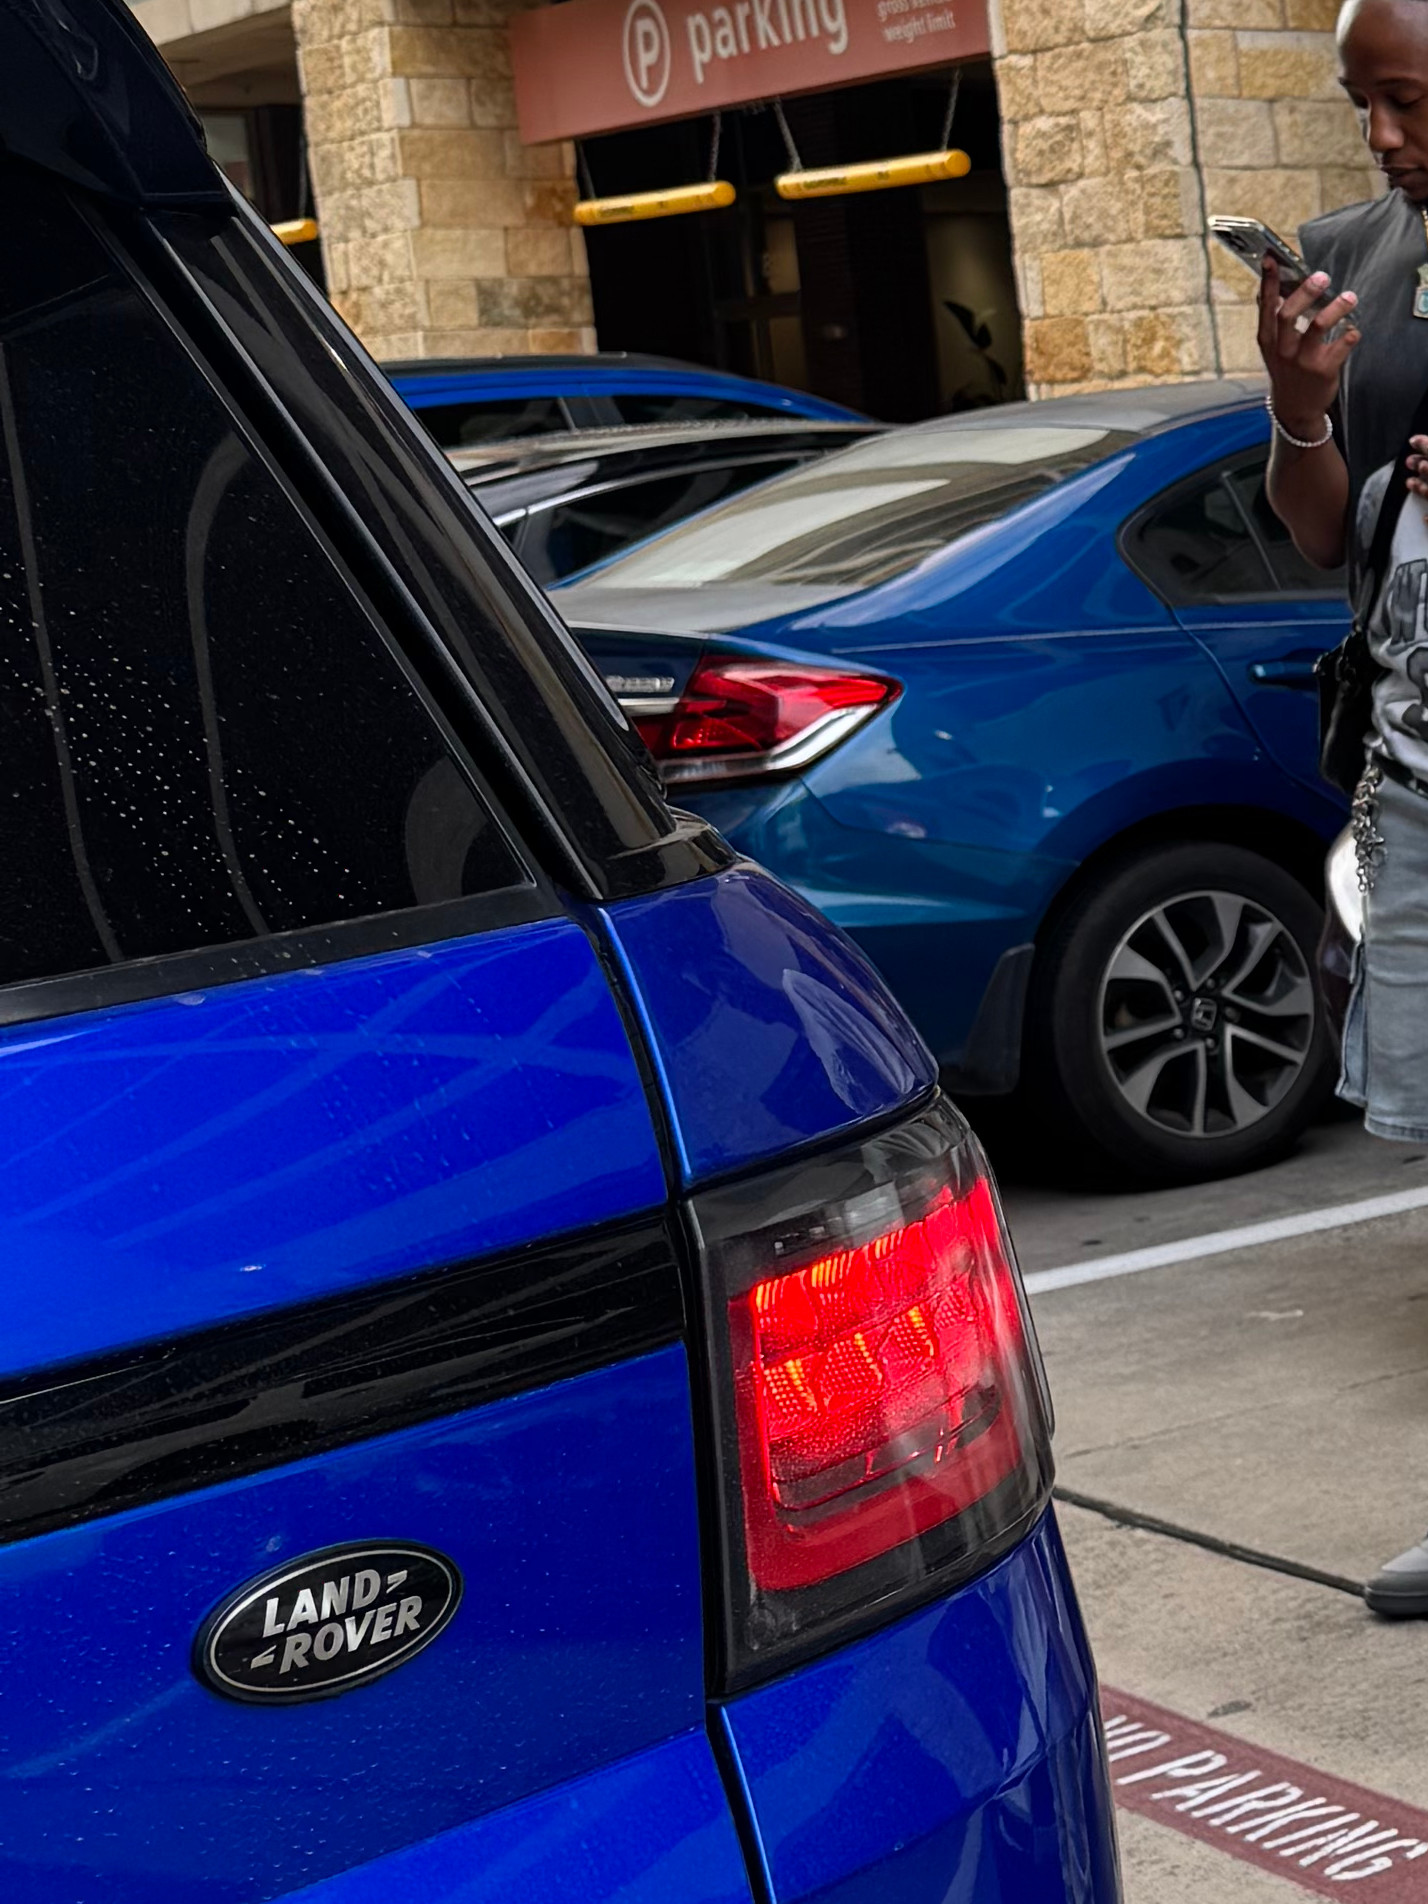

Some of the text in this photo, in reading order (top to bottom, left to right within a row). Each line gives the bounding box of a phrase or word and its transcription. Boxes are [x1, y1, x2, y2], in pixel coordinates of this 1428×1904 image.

[884, 9, 956, 44] weight limit
[262, 1568, 381, 1638] LAND
[278, 1595, 424, 1675] ROVER
